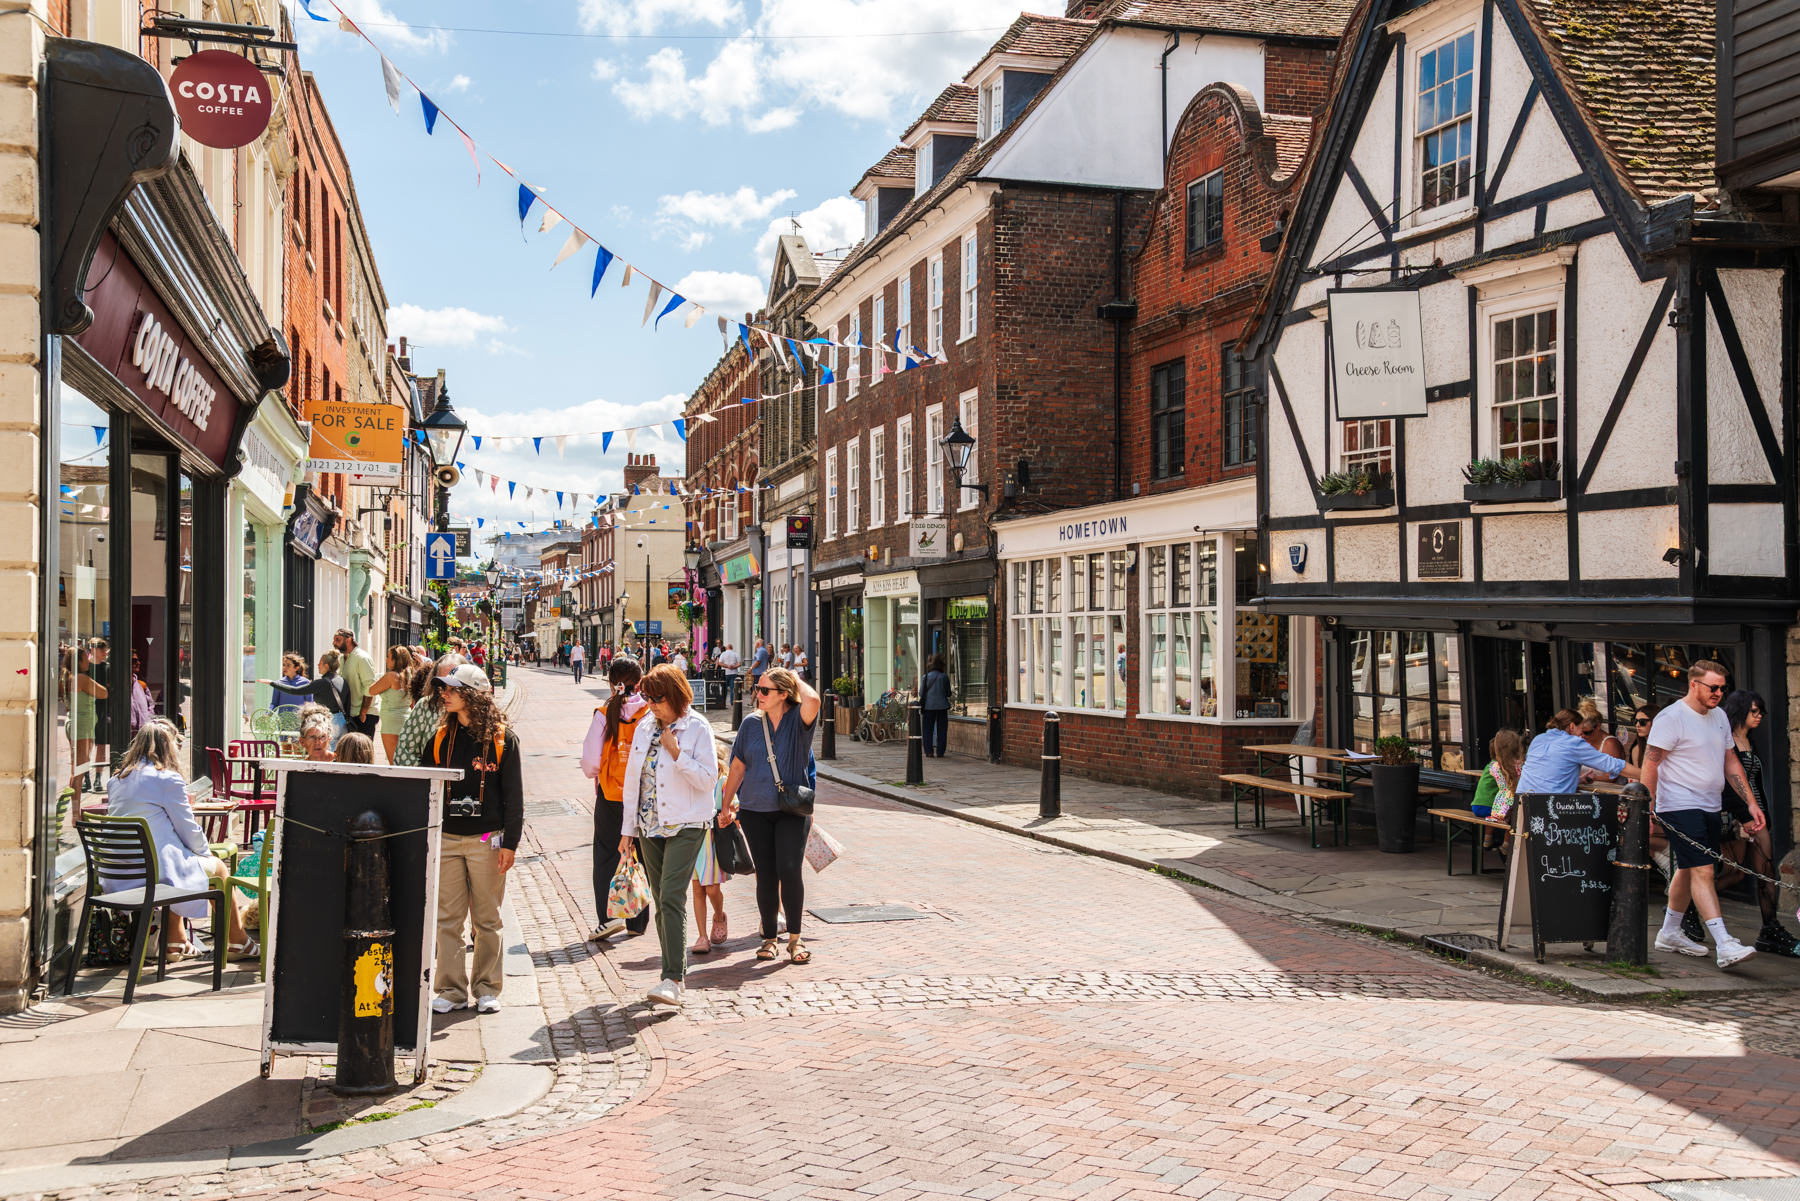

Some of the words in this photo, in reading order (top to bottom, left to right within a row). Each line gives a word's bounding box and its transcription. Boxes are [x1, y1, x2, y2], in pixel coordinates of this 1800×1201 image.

[178, 80, 262, 104] COSTA
[197, 104, 244, 116] COFFEE
[132, 312, 180, 396] COSTA
[171, 357, 217, 432] COFFEE
[1345, 361, 1381, 377] Cheese
[1383, 360, 1416, 376] Room
[325, 405, 383, 416] INVESTMENT
[312, 413, 346, 428] FOR
[354, 415, 395, 431] SALE
[334, 461, 353, 471] 212
[1059, 516, 1127, 541] HOMETOWN
[892, 576, 909, 590] HEART
[1236, 710, 1249, 718] 62
[1576, 802, 1593, 810] Room
[1543, 822, 1611, 854] Breakfast
[358, 1002, 370, 1012] At
